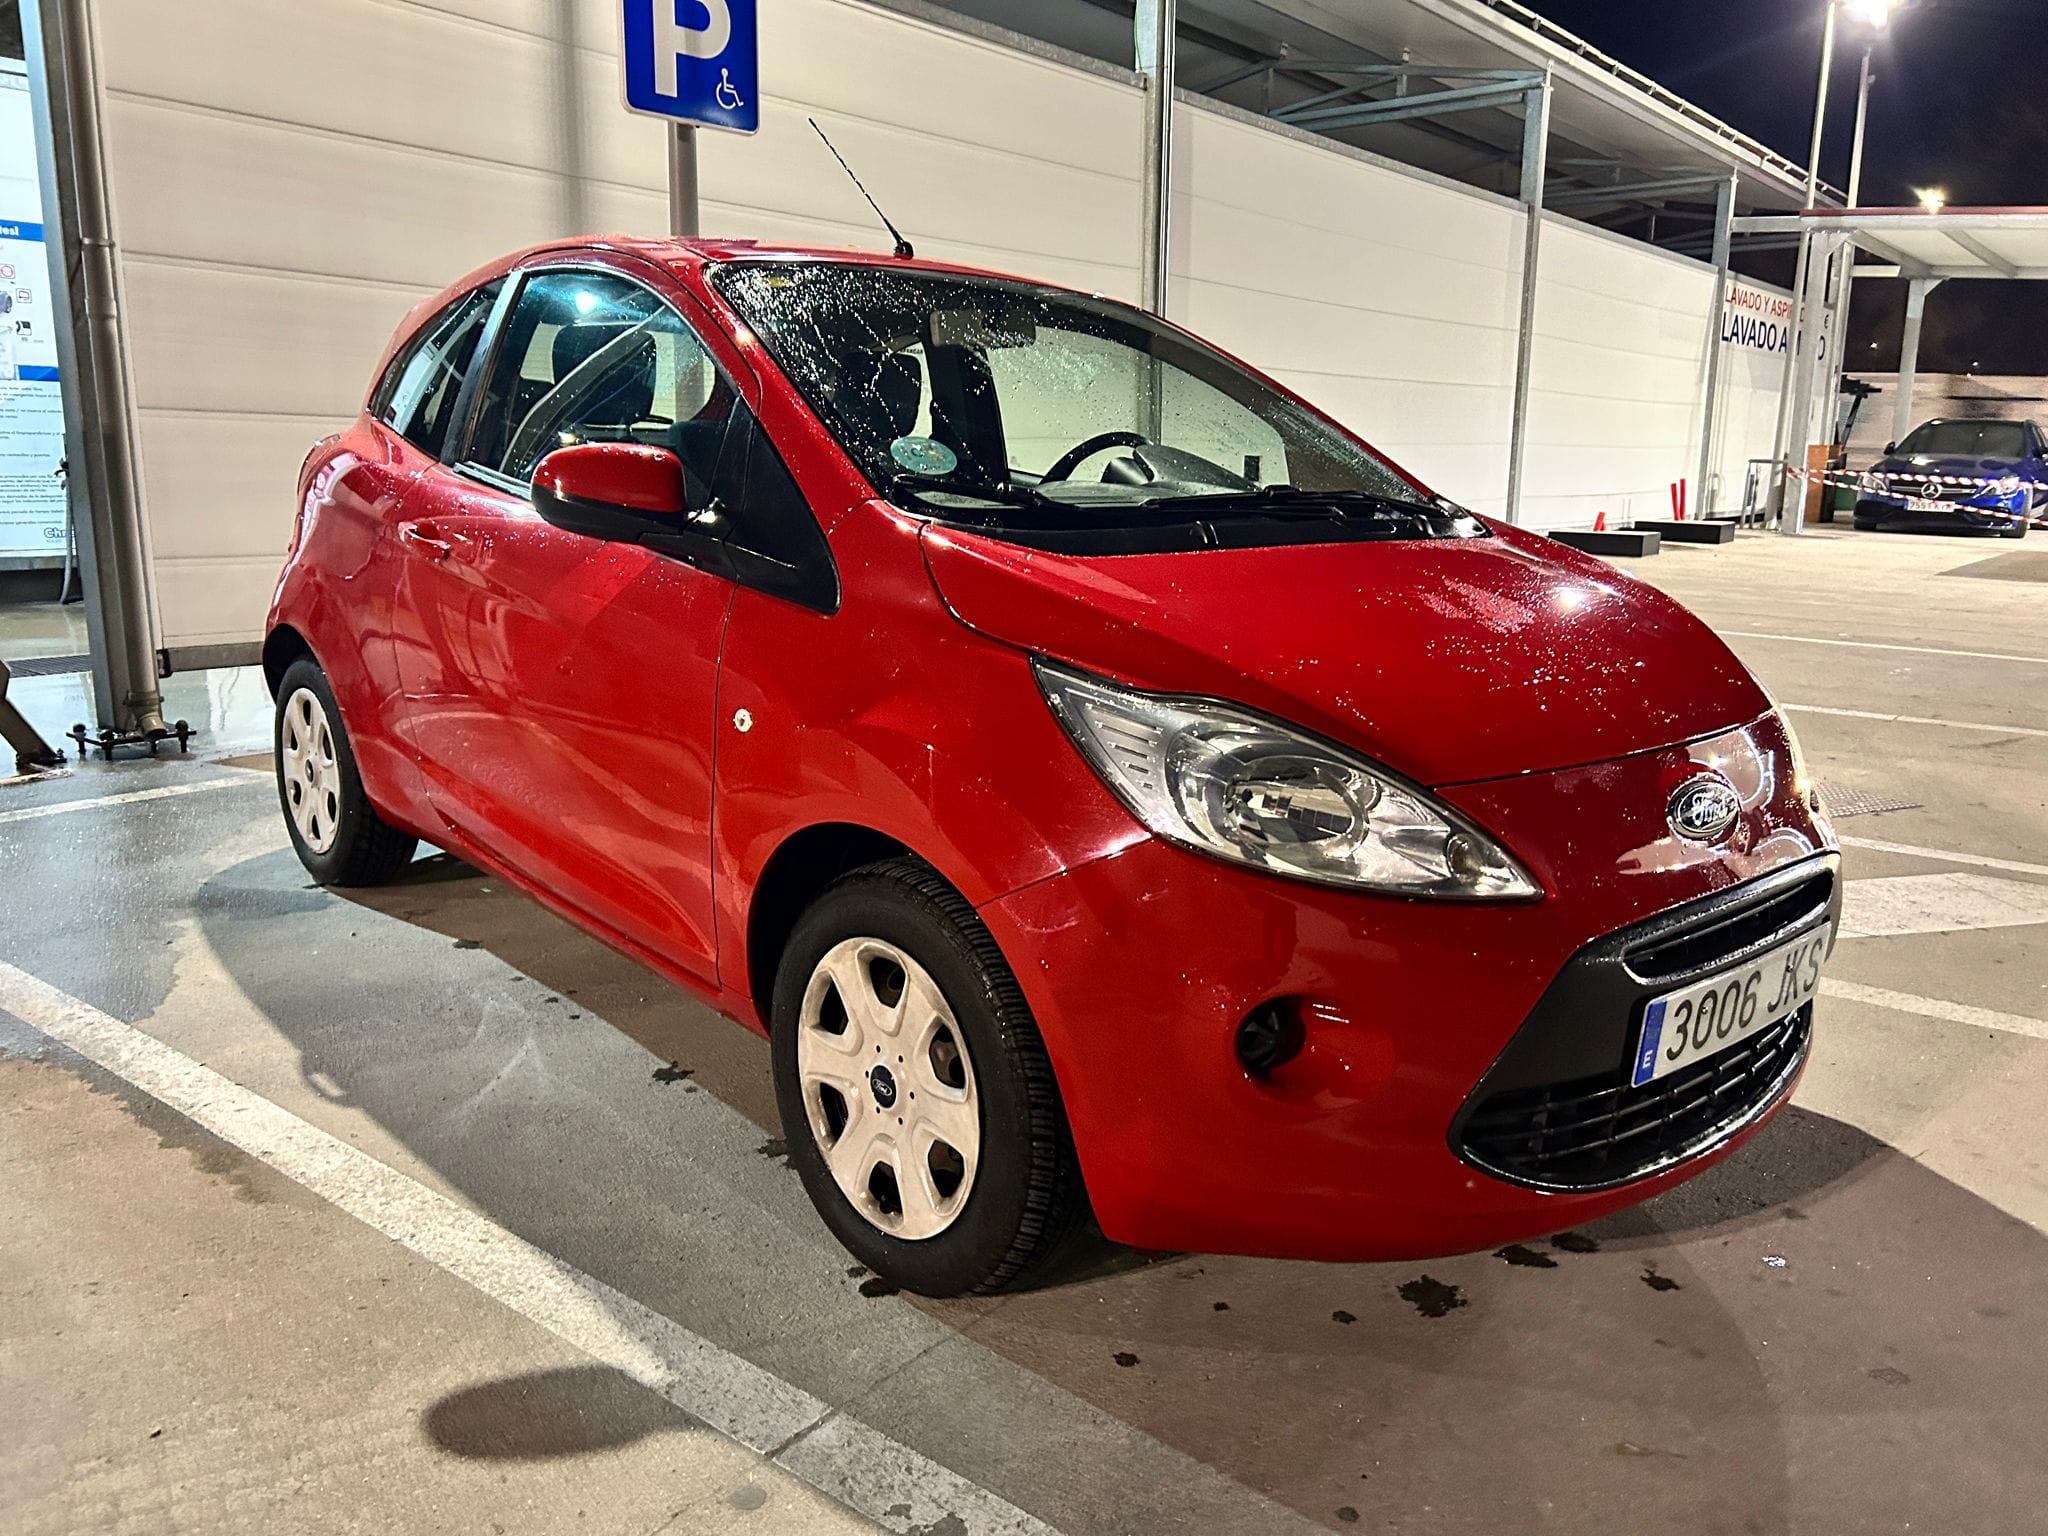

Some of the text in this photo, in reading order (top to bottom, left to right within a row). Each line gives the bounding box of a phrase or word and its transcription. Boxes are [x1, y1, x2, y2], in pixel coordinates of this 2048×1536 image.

[652, 0, 731, 98] P
[1725, 285, 1762, 311] LAVADO
[1763, 295, 1771, 312] Y
[1721, 311, 1777, 351] LAVADO
[1778, 326, 1787, 353] A
[44, 527, 66, 539] Chr
[1666, 937, 1823, 1061] 3006 JKS
[1642, 1050, 1653, 1069] E
